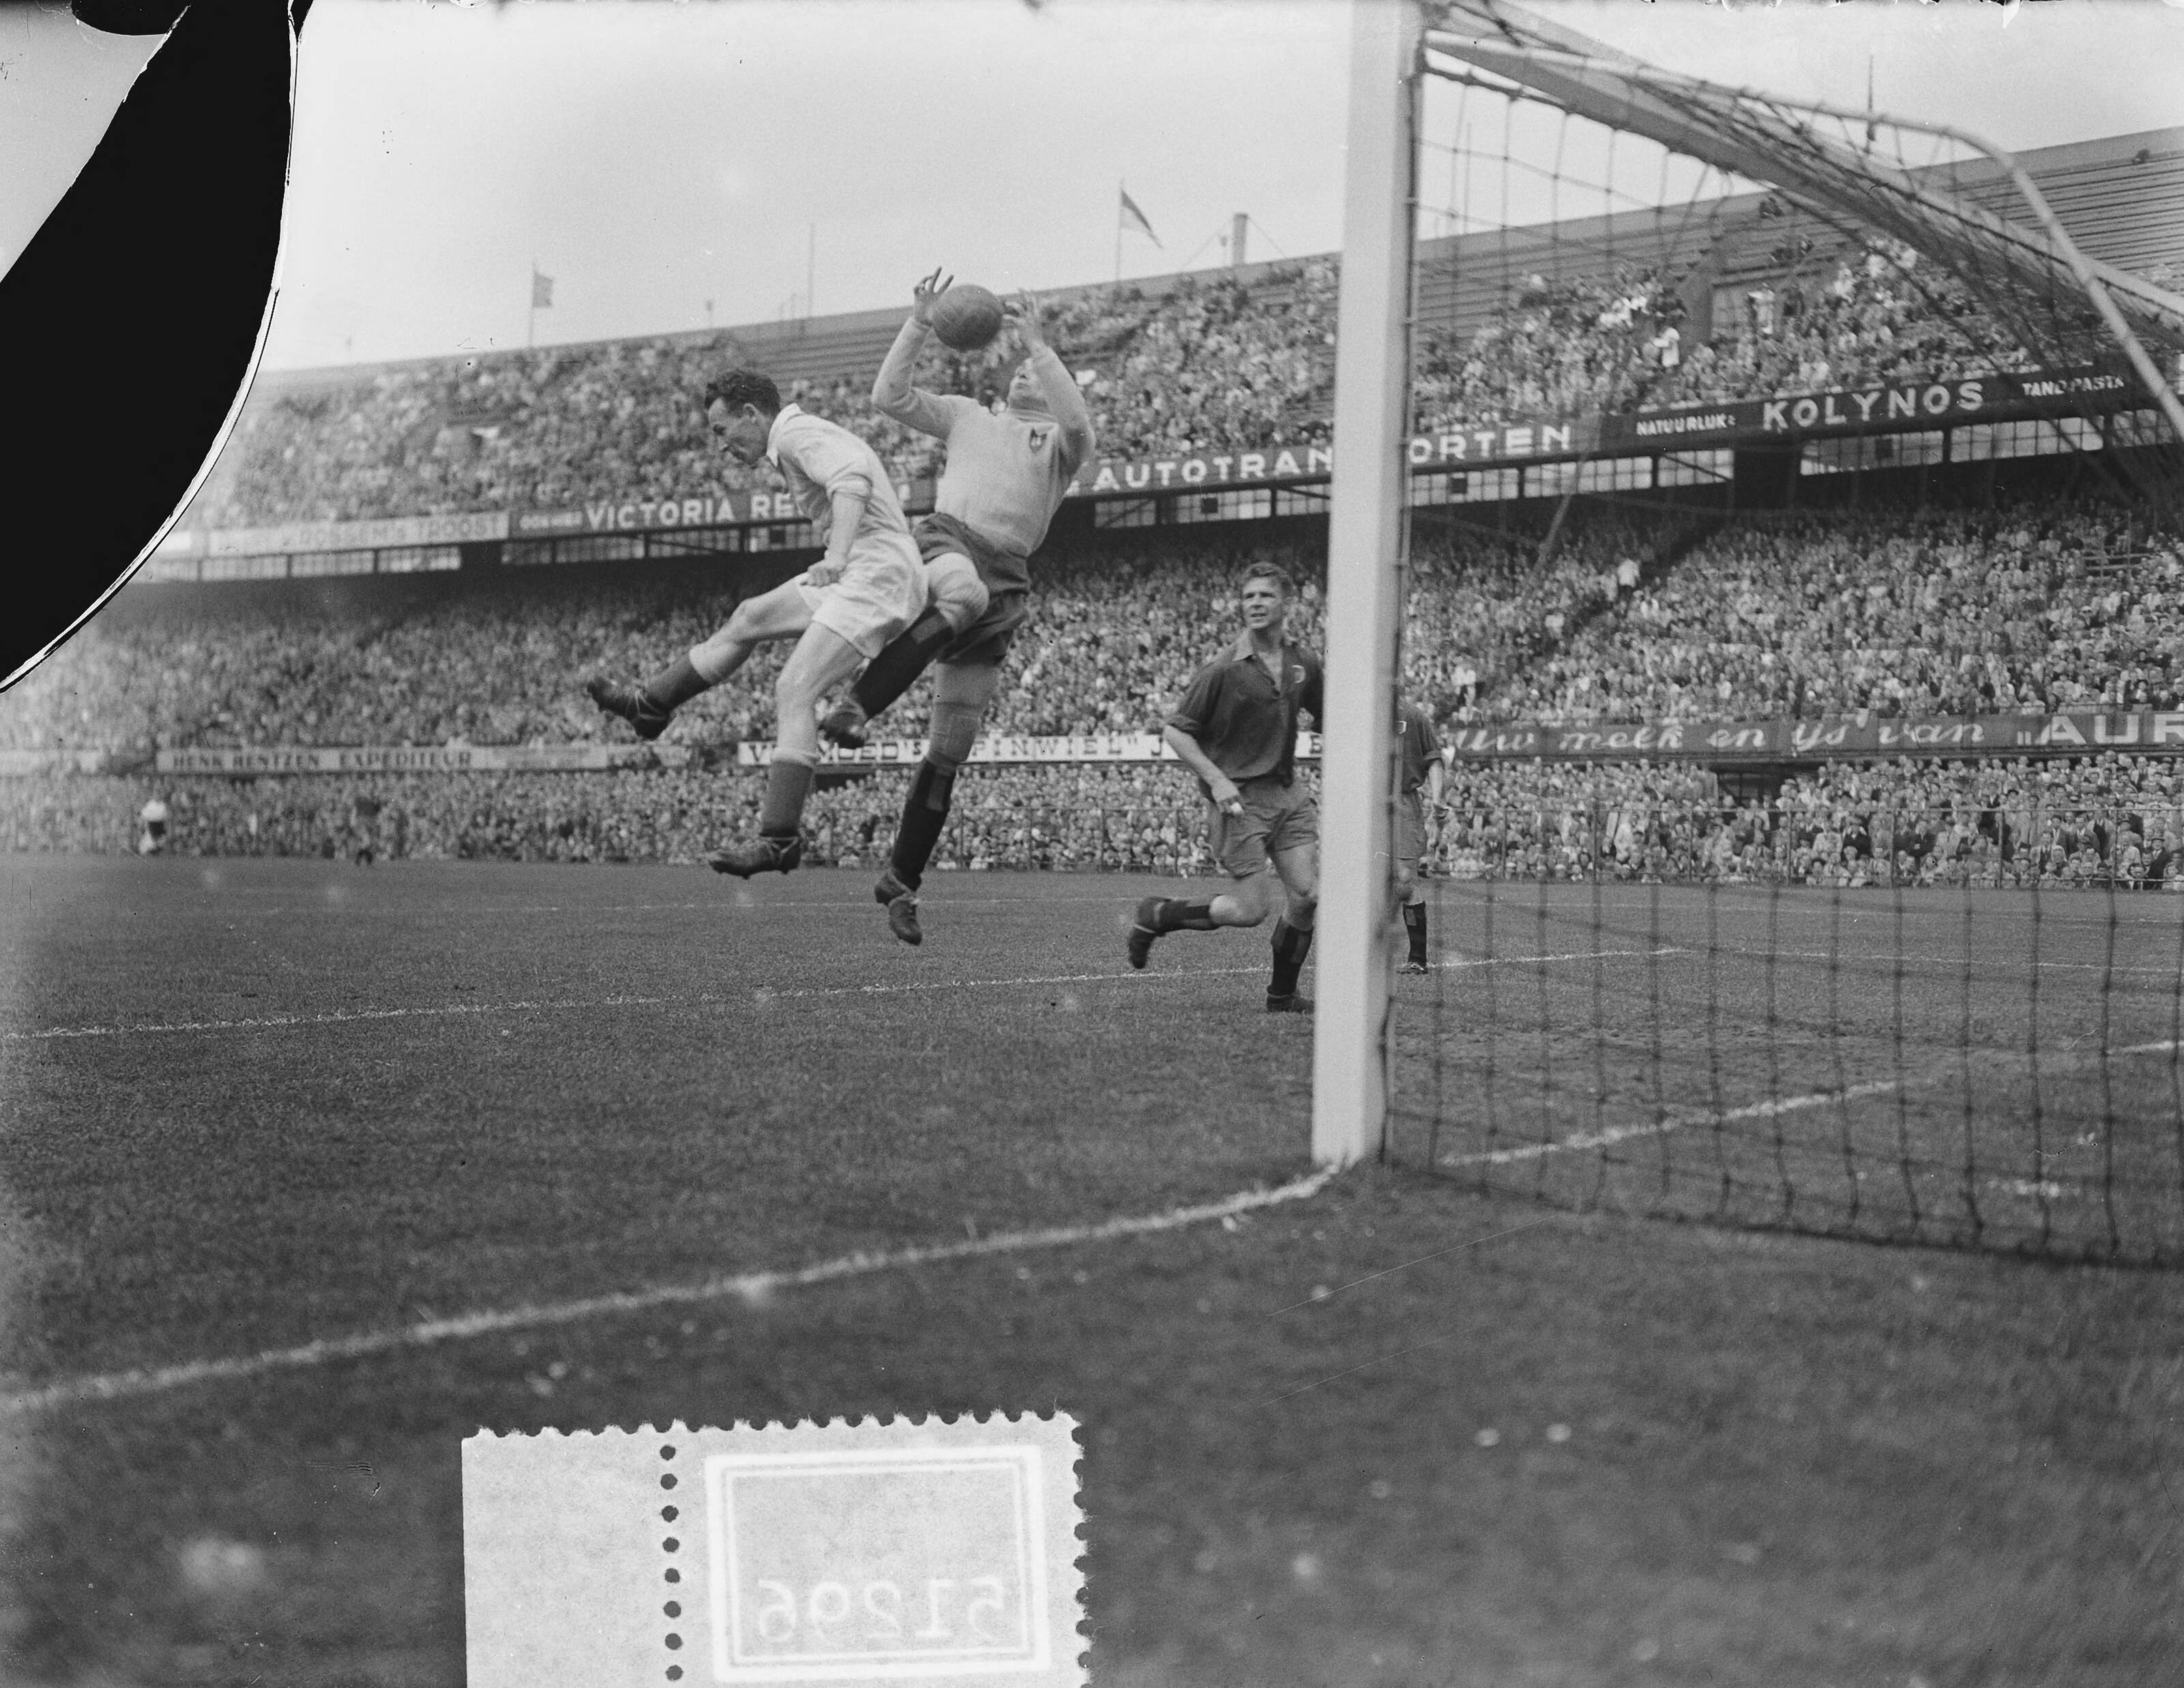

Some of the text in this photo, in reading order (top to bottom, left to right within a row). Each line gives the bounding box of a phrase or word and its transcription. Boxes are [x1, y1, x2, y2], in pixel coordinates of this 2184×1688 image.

[1762, 381, 1984, 432] KOLYNOS
[1093, 424, 1570, 492] AUTOTRANORTEN
[585, 499, 735, 530] VICTORIA
[1707, 728, 1766, 747] en
[1877, 723, 1985, 744] van
